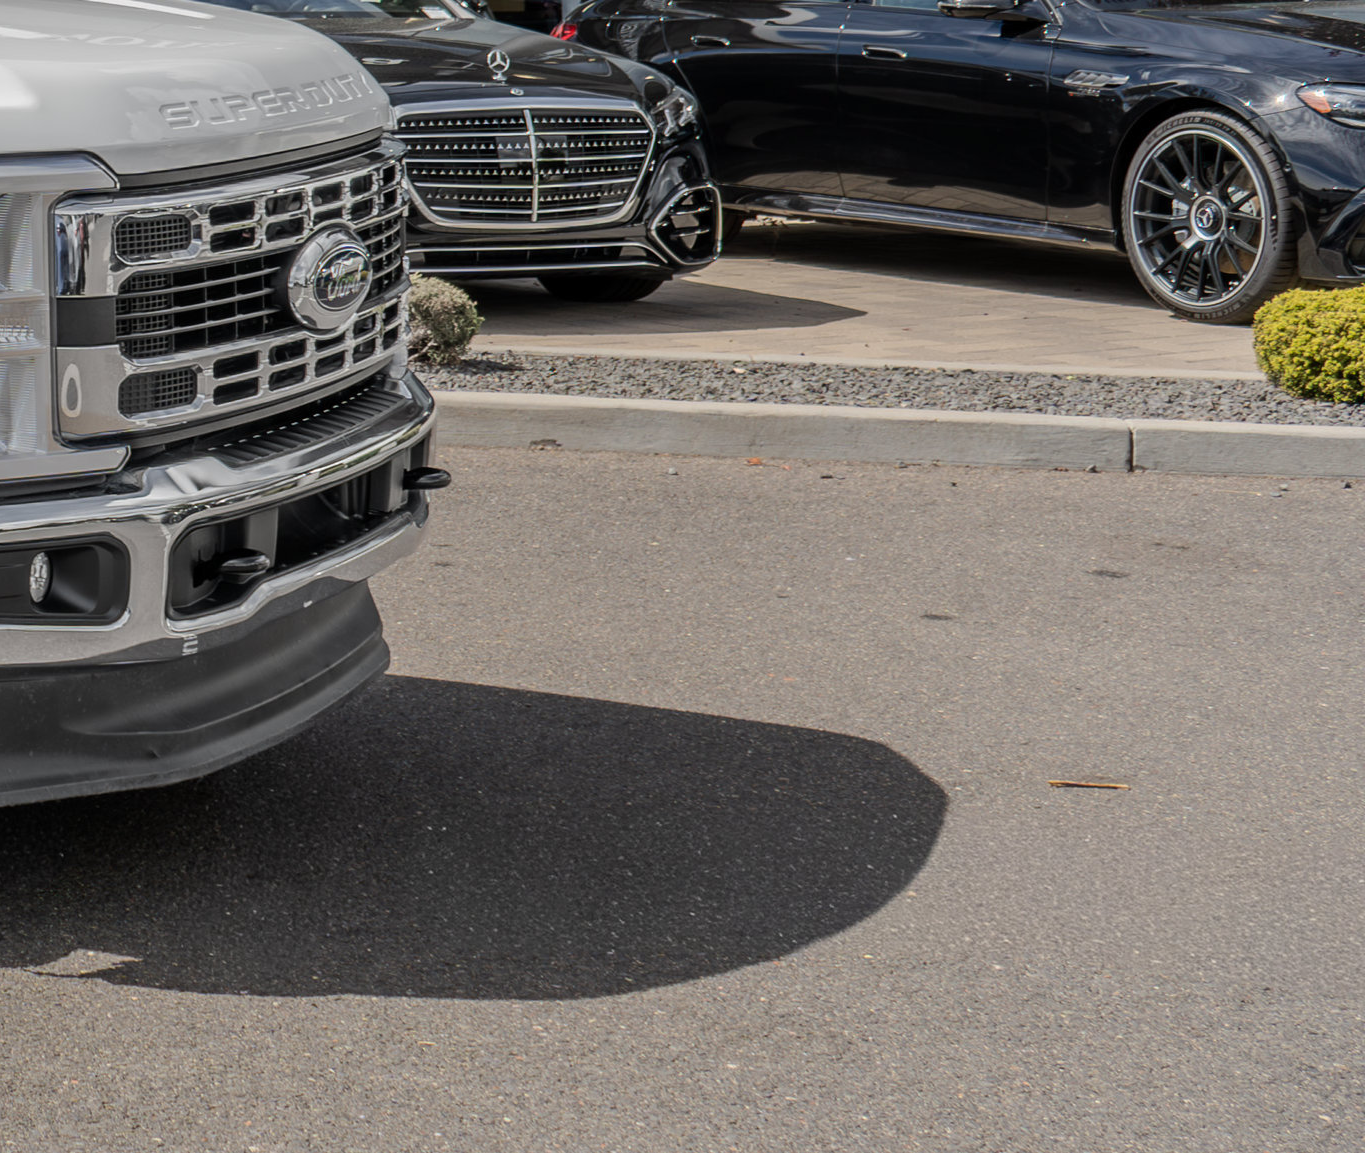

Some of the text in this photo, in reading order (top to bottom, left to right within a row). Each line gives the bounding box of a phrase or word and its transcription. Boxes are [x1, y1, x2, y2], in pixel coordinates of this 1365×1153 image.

[158, 71, 374, 130] SUPER DUTY
[321, 251, 366, 301] Ford
